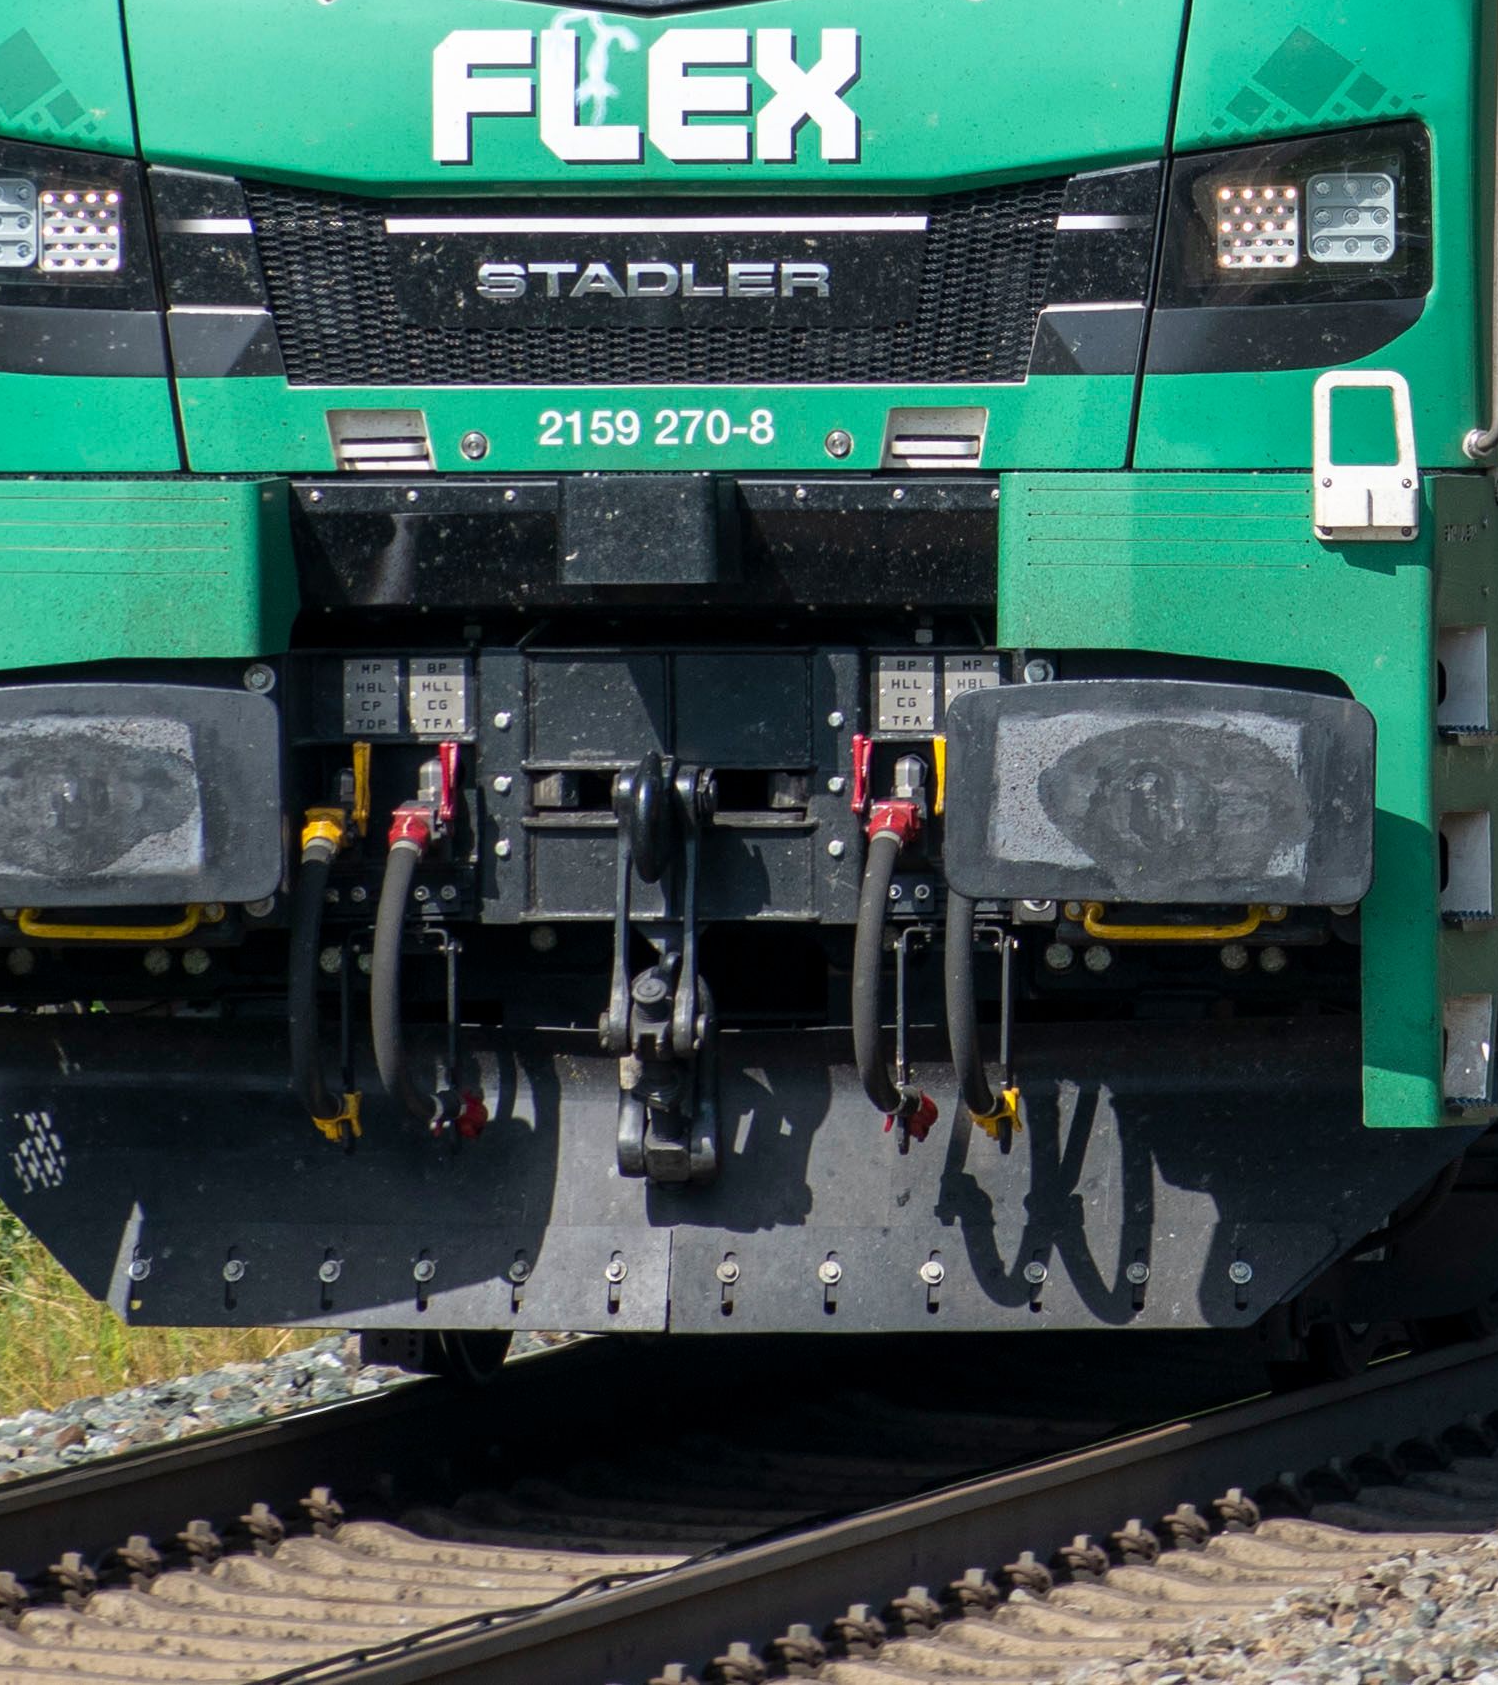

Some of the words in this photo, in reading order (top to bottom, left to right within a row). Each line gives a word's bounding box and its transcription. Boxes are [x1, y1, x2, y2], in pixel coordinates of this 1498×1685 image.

[432, 28, 861, 165] FLEX
[477, 263, 830, 298] STADLER
[539, 409, 640, 446] 2159
[655, 408, 775, 446] 270-8
[427, 663, 447, 673] BP
[896, 660, 917, 670] BP
[355, 683, 387, 693] HBL
[422, 682, 452, 691] HLL
[891, 679, 922, 689] HLL
[957, 678, 987, 688] HBL
[361, 701, 382, 711] CP
[427, 700, 448, 710] CG
[897, 697, 917, 707] CG
[357, 719, 387, 730] TDP
[423, 718, 453, 729] TFA
[892, 716, 922, 726] TFA
